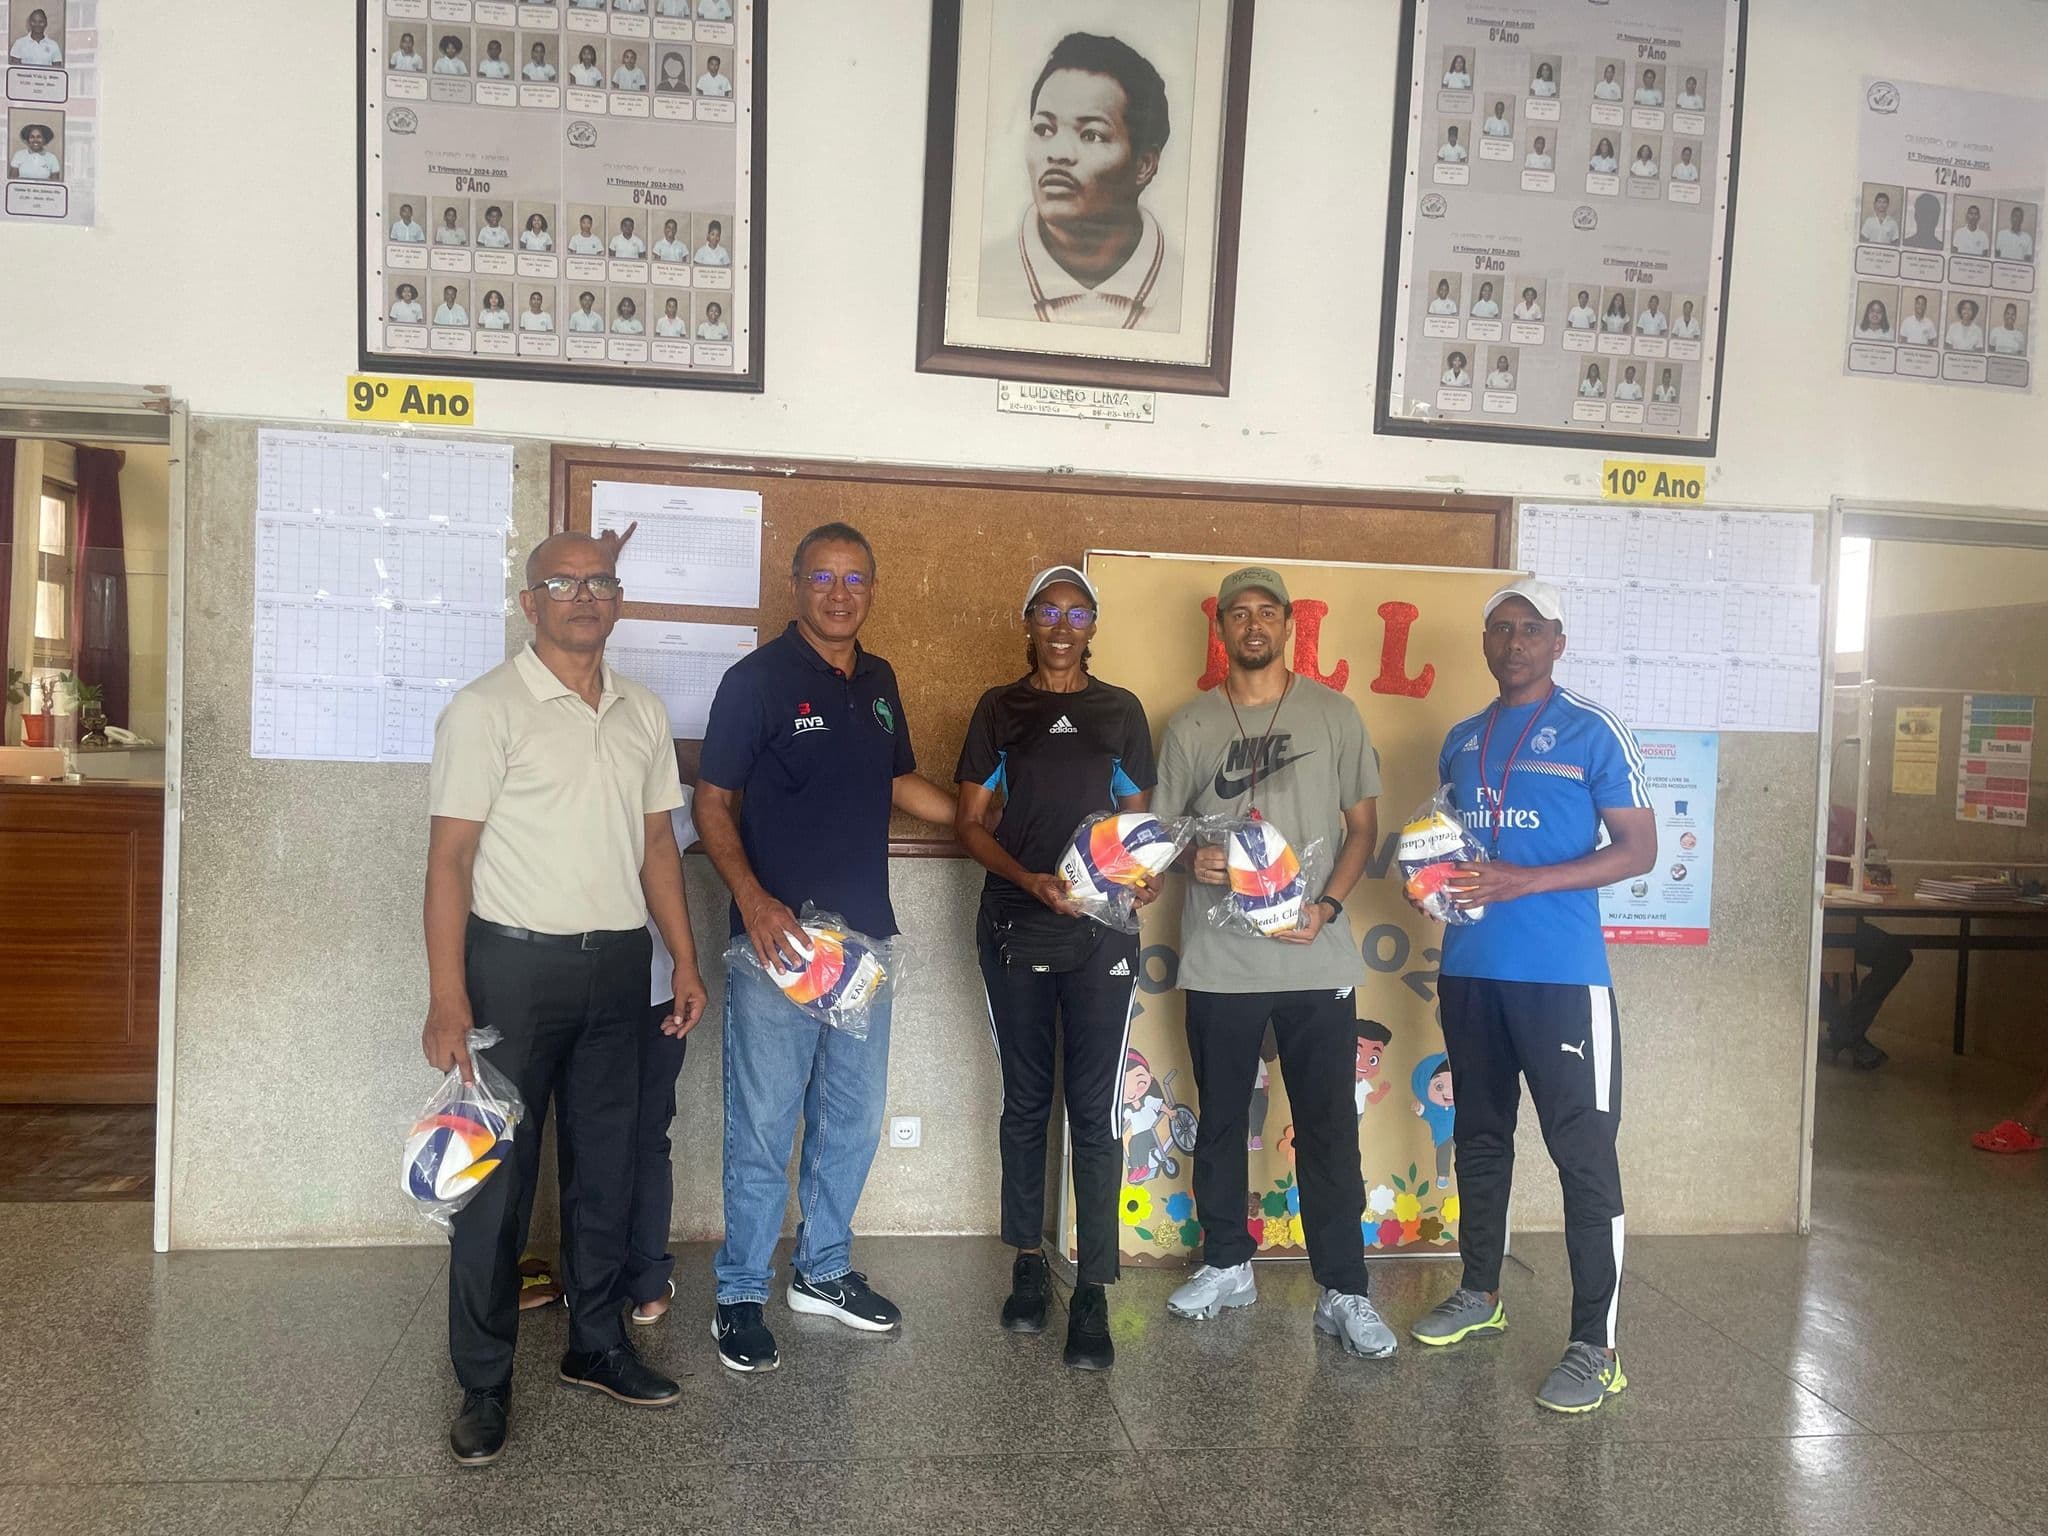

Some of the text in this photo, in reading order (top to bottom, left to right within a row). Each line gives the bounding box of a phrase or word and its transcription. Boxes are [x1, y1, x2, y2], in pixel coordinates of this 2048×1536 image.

[353, 381, 469, 417] 9º Ano
[1608, 468, 1700, 499] 10º Ano
[1225, 733, 1292, 773] NIKE
[1476, 786, 1502, 806] Fly
